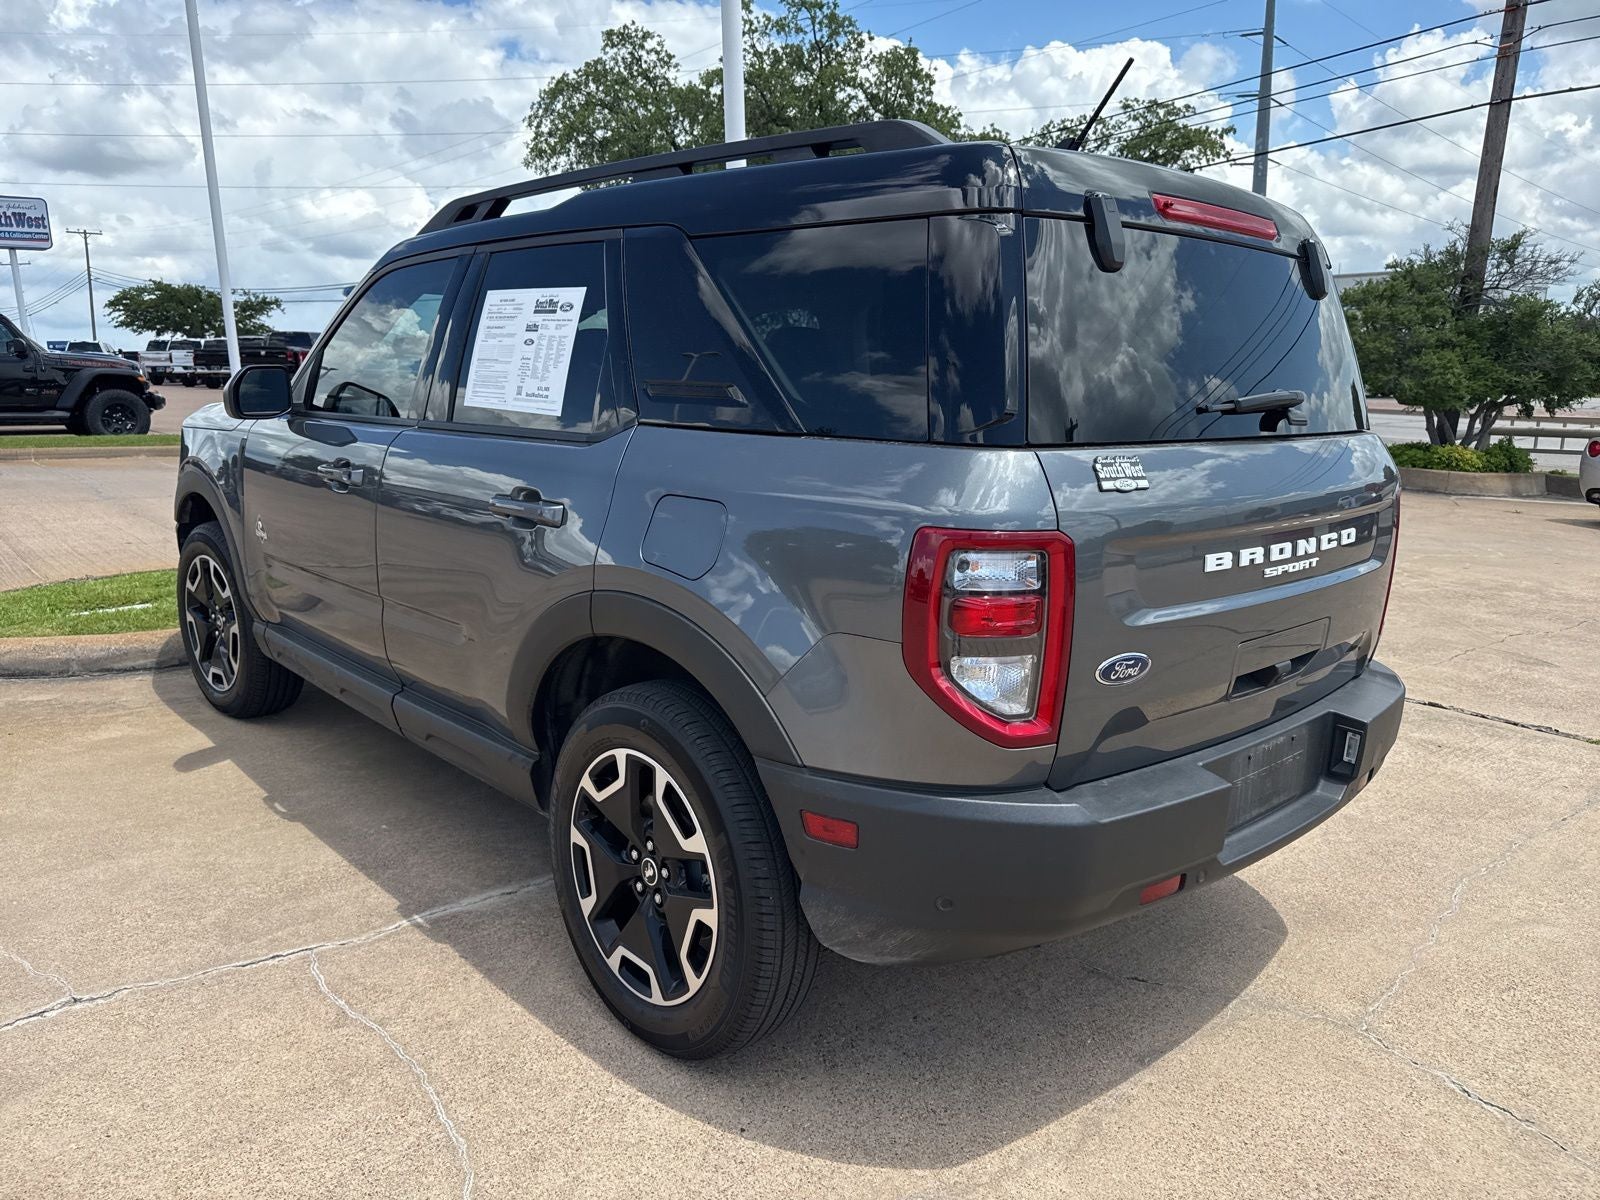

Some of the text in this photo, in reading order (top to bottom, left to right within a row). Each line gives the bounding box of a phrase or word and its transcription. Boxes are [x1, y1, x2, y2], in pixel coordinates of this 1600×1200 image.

[1096, 463, 1146, 478] SouthWest
[1204, 527, 1357, 573] BRONCO
[1263, 557, 1320, 578] SPORT
[1110, 660, 1142, 680] Ford
